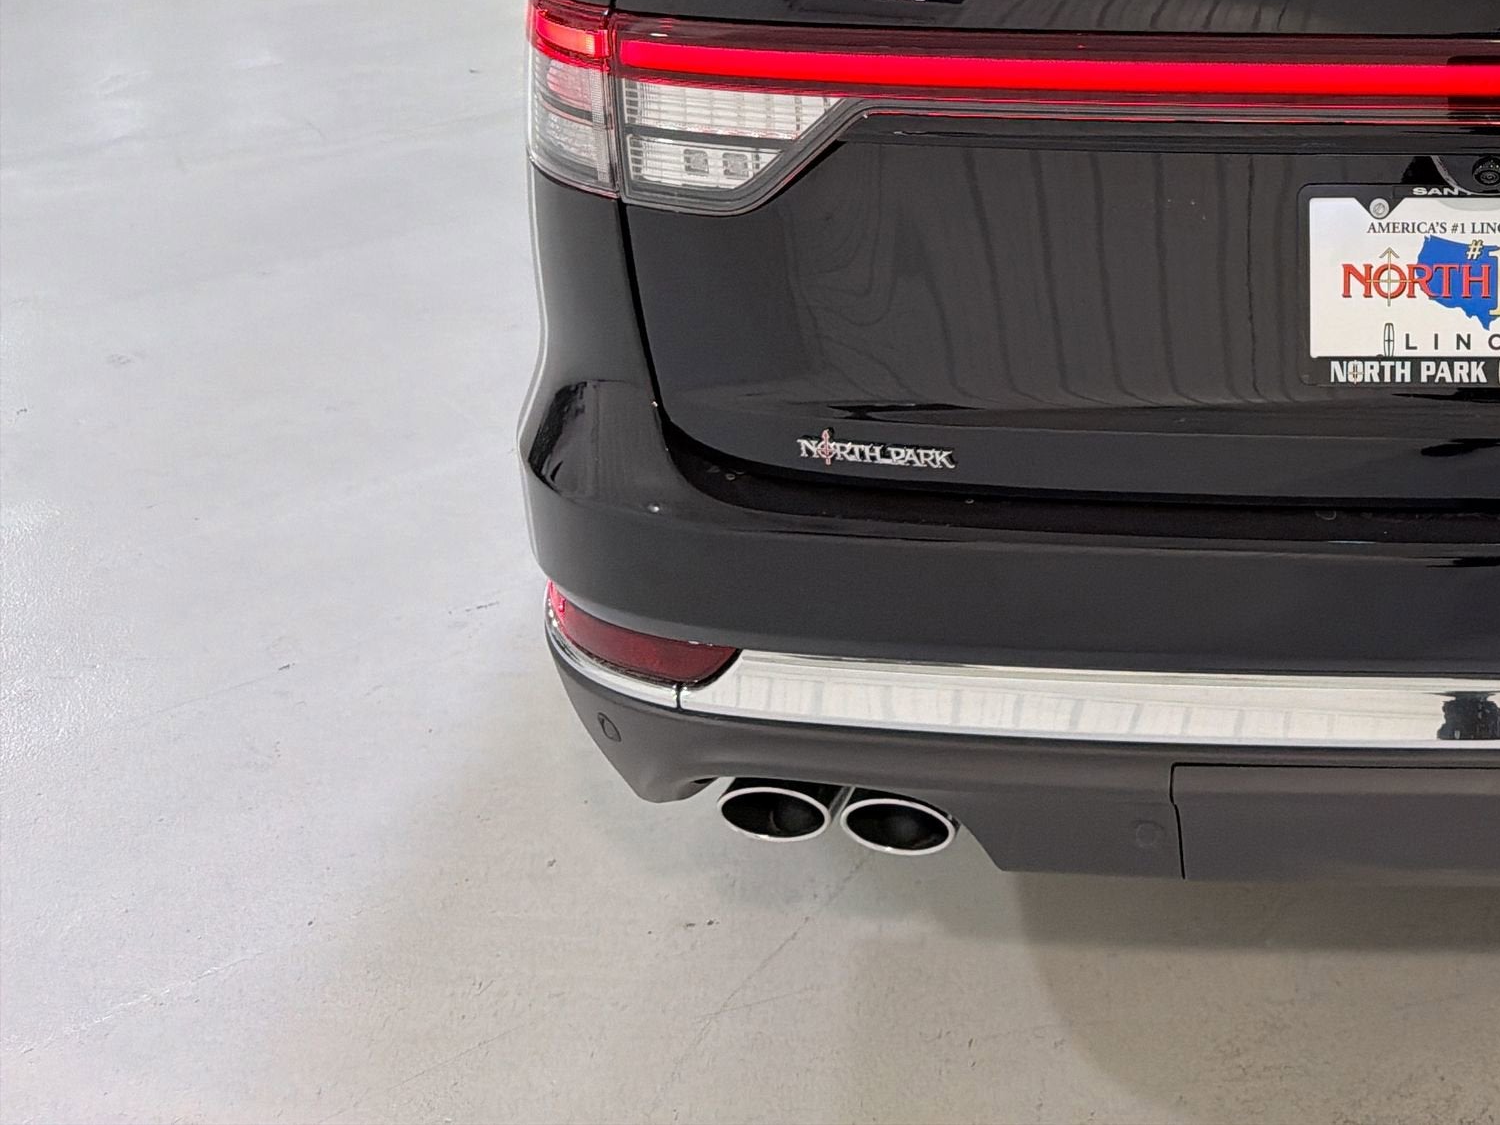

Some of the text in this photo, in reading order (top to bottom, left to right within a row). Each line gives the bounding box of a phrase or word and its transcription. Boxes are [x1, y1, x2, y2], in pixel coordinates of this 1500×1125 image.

[1412, 187, 1459, 195] SAN
[1367, 222, 1447, 234] AMERICA'S
[1451, 222, 1465, 234] #1
[1342, 263, 1491, 299] NORTH
[1330, 360, 1411, 383] NORTH
[1420, 361, 1488, 383] PARK
[797, 438, 955, 469] NORTH PARK
